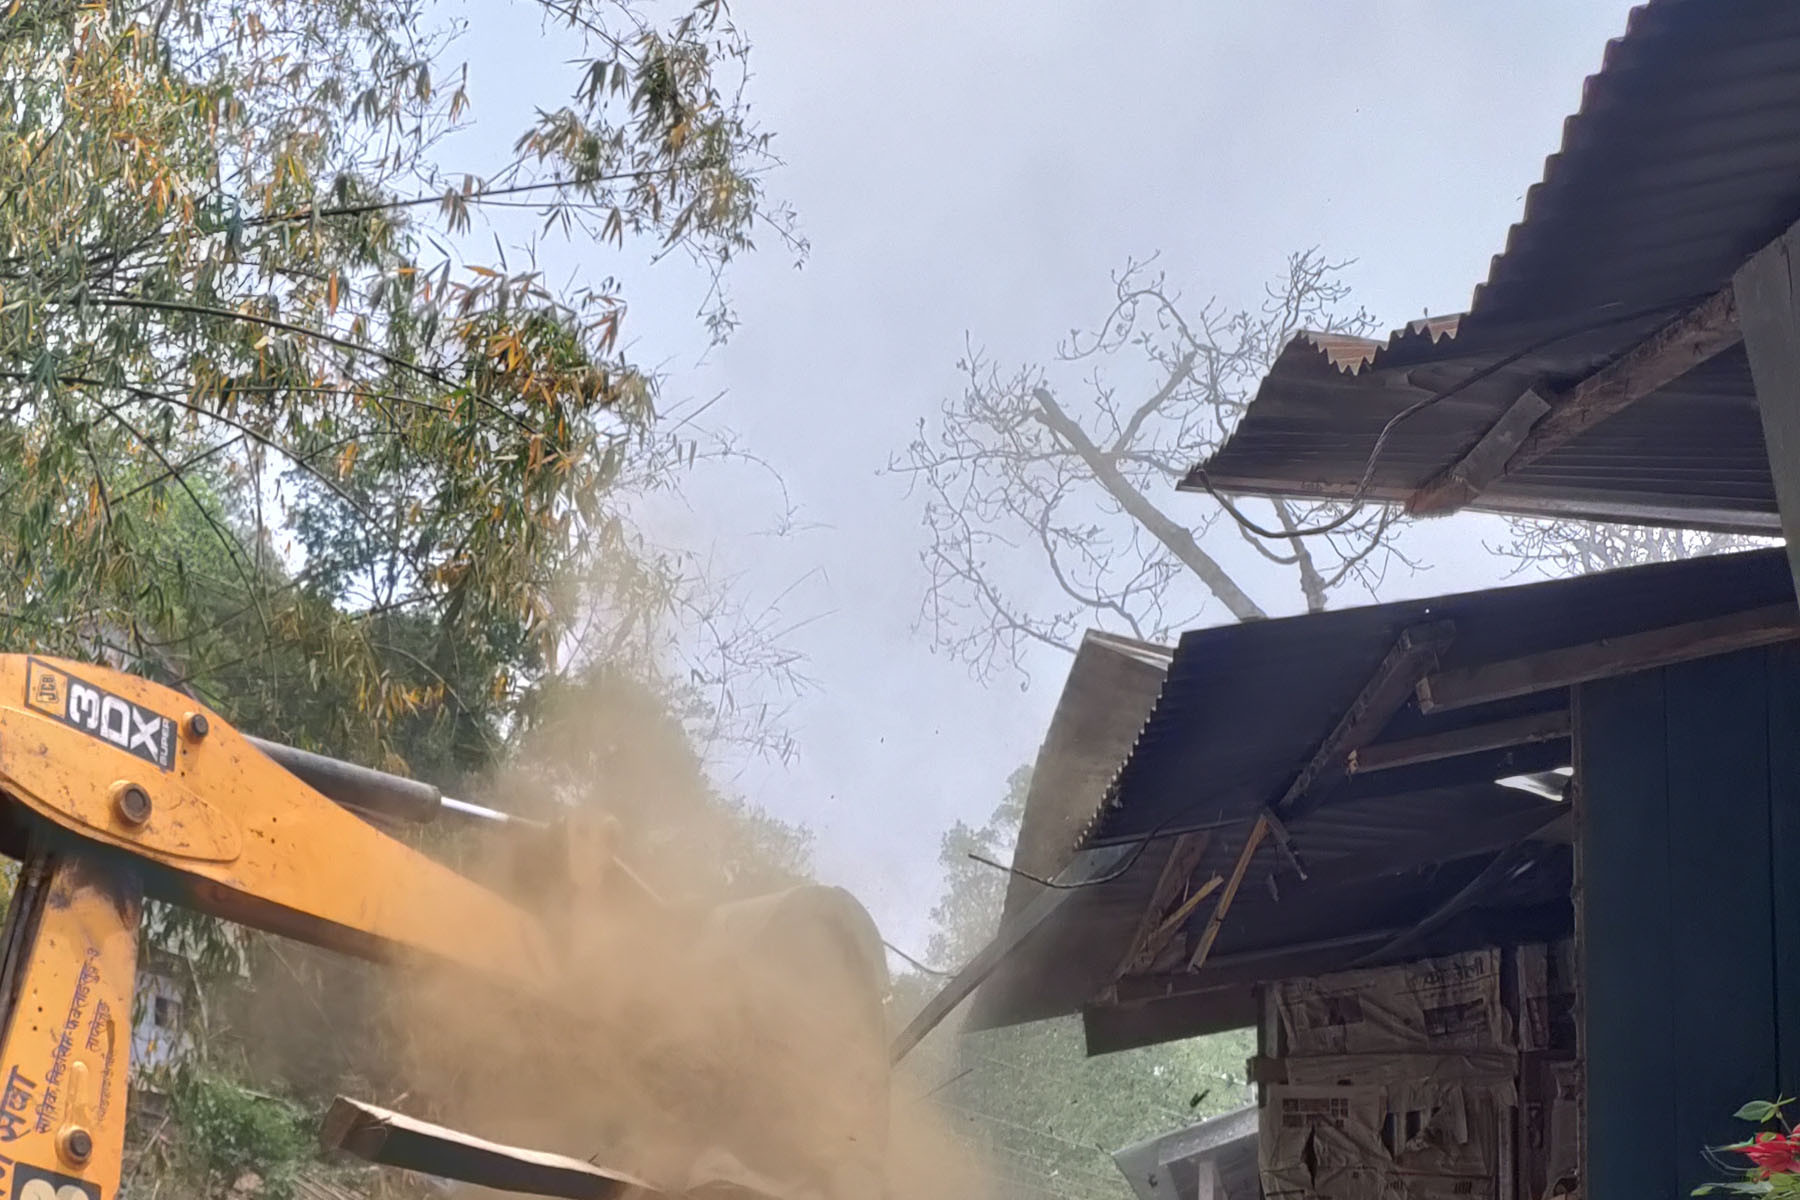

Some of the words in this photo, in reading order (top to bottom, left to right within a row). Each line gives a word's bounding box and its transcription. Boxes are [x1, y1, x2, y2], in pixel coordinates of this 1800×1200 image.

[38, 675, 57, 701] JCB
[69, 683, 161, 763] 3DX
[159, 718, 170, 766] SUPER
